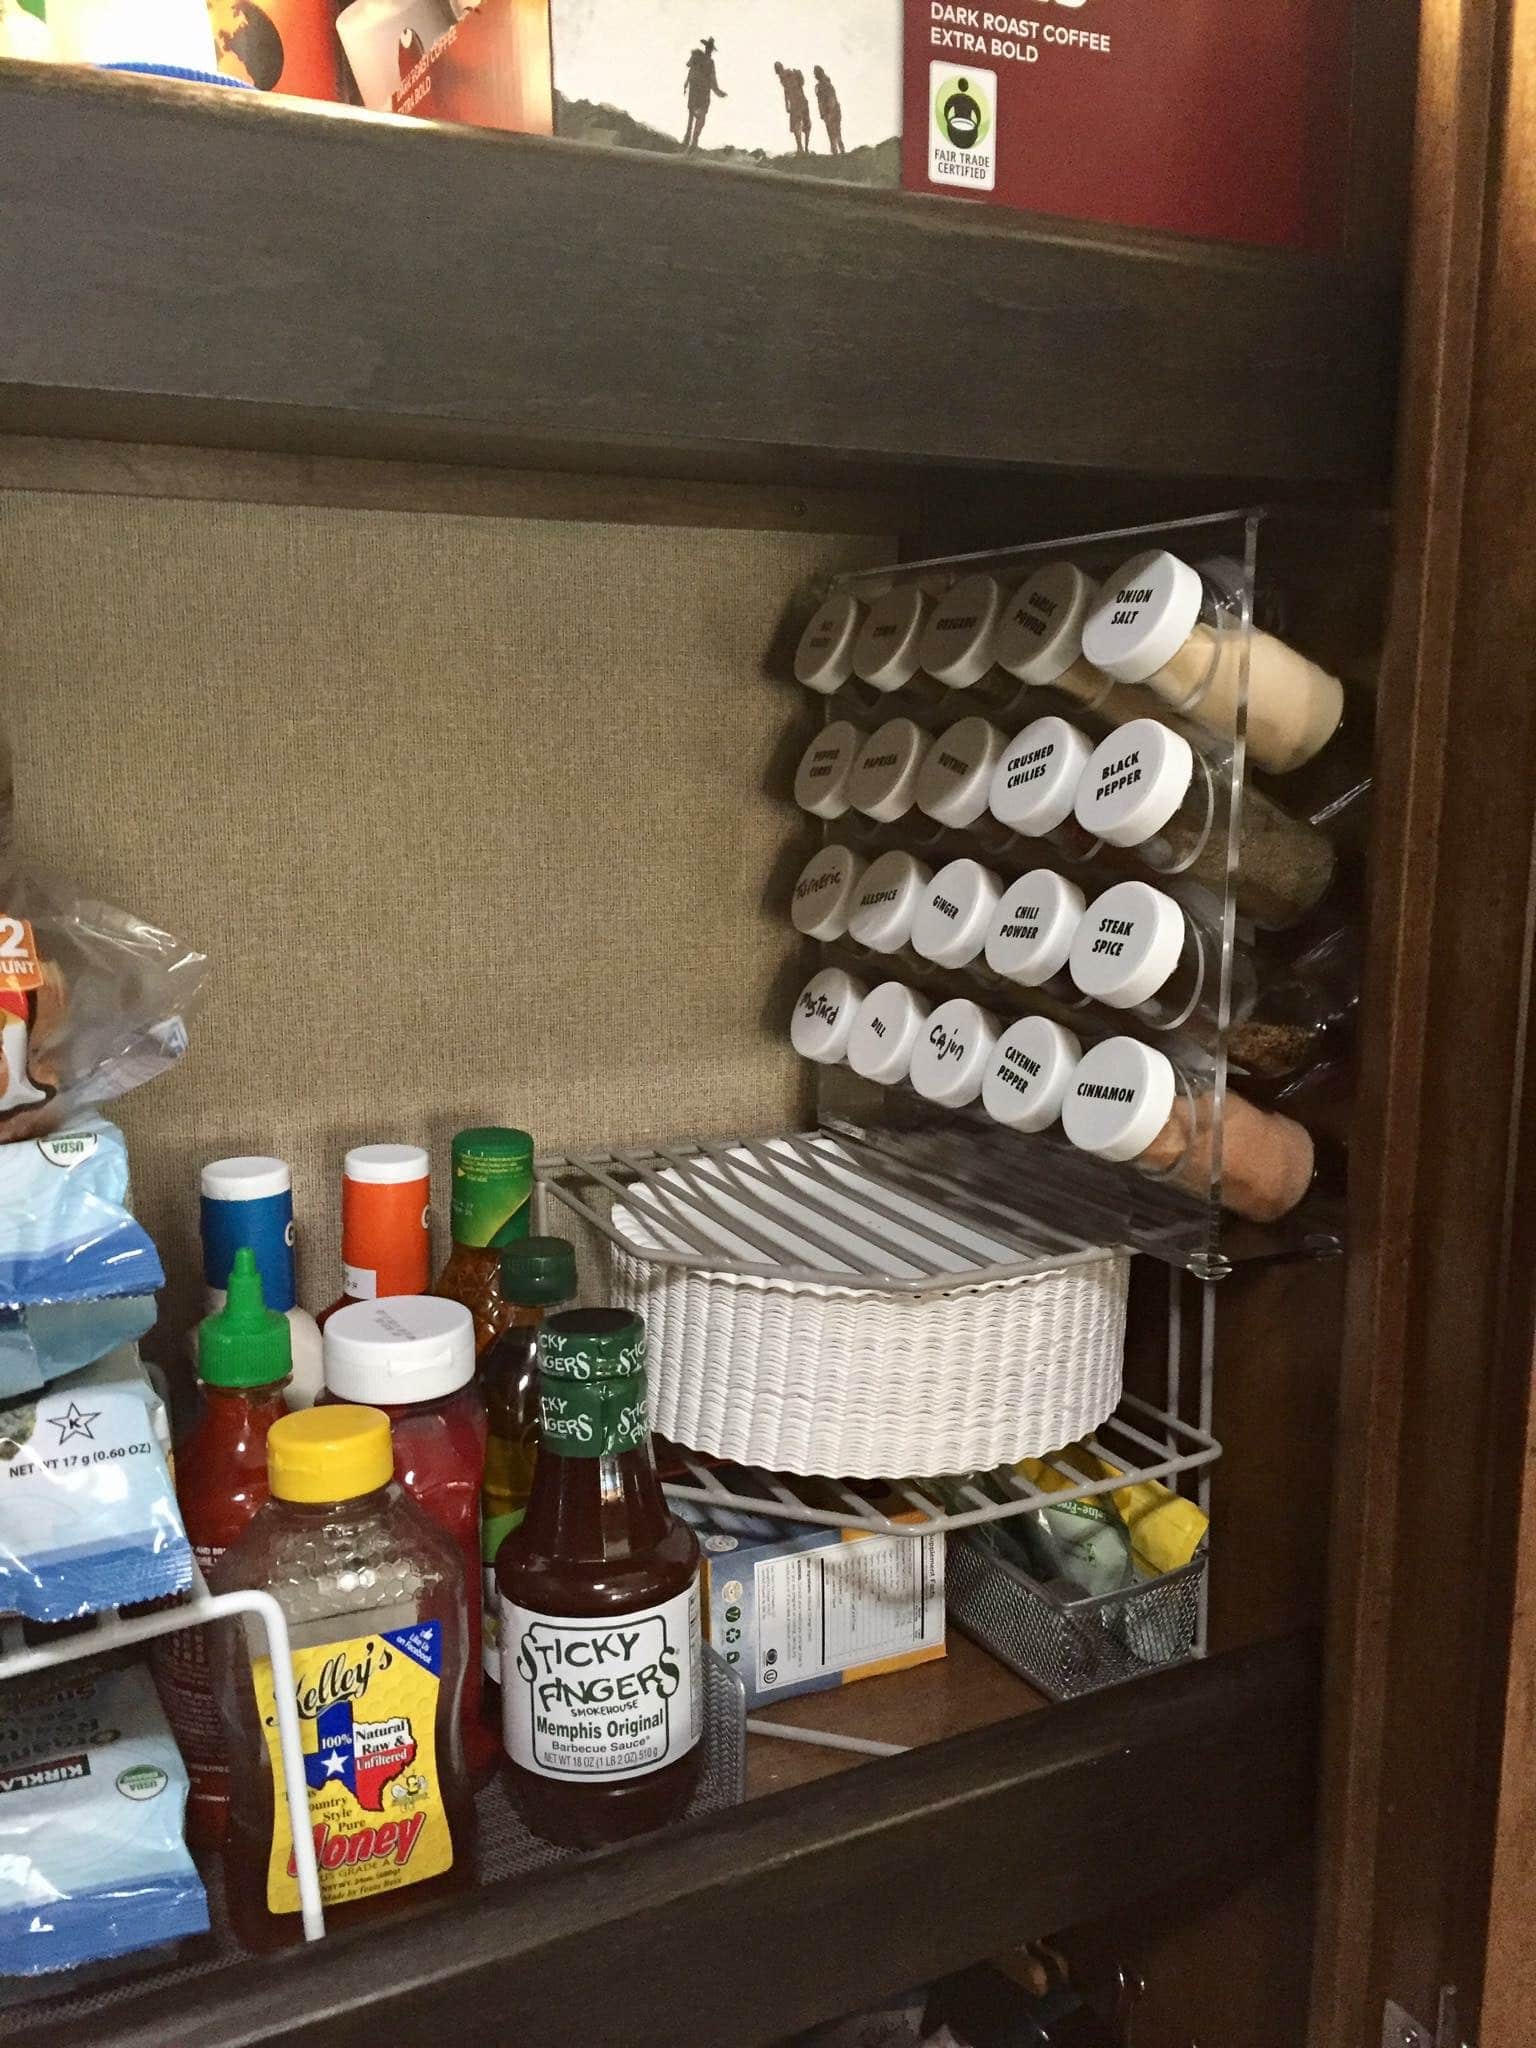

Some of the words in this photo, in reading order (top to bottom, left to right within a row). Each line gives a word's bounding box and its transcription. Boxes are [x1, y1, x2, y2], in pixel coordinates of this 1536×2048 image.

[931, 2, 979, 28] DARK
[983, 13, 1040, 39] ROAST
[1043, 24, 1111, 52] COFFEE
[930, 27, 987, 54] EXTRA
[991, 39, 1039, 63] BOLD
[934, 149, 957, 163] FAIR
[959, 152, 990, 168] TRADE
[938, 162, 986, 180] CERTIFIED
[1116, 589, 1153, 604] ONION
[1111, 611, 1139, 625] SALT
[863, 753, 898, 769] PAPRIKA
[1007, 743, 1054, 772] CRUSHED
[1101, 750, 1140, 781] BLACK
[1007, 763, 1047, 789] CHILIES
[1096, 769, 1142, 801] PEPPER
[860, 889, 898, 906] ALLSPICE
[932, 895, 959, 920] GINGER
[1014, 906, 1040, 921] CHILI
[1000, 924, 1038, 940] POWDER
[1099, 918, 1134, 937] STEAK
[1092, 939, 1124, 957] SPICE
[0, 960, 34, 975] UNT
[870, 1016, 886, 1039] DILL
[1005, 1046, 1041, 1078] CAYENNE
[997, 1064, 1029, 1094] PEPPER
[1077, 1082, 1135, 1103] CINNAMON
[51, 1141, 84, 1154] USDA
[69, 1418, 81, 1430] K
[9, 1463, 34, 1478] NET
[63, 1456, 77, 1467] 17
[82, 1455, 90, 1466] g
[94, 1449, 125, 1463] (0.60
[128, 1442, 152, 1456] OZ)
[517, 1632, 640, 1683] STICKY
[538, 1646, 680, 1712] FINGERS
[570, 1700, 639, 1718] SMOKEHOUSE
[536, 1715, 602, 1742] Memphis
[606, 1708, 663, 1738] Original
[321, 1733, 353, 1750] 100%
[355, 1720, 405, 1741] Natural
[362, 1740, 391, 1756] Raw
[394, 1735, 407, 1748] &
[552, 1740, 607, 1754] Barbecue
[356, 1748, 408, 1771] Unfiltered
[559, 1755, 571, 1766] WT
[573, 1757, 581, 1768] 18
[584, 1756, 595, 1768] OZ
[618, 1755, 623, 1766] 2
[309, 1796, 348, 1812] ountry
[322, 1808, 353, 1822] Style
[338, 1818, 366, 1833] Pure
[382, 1858, 391, 1867] A
